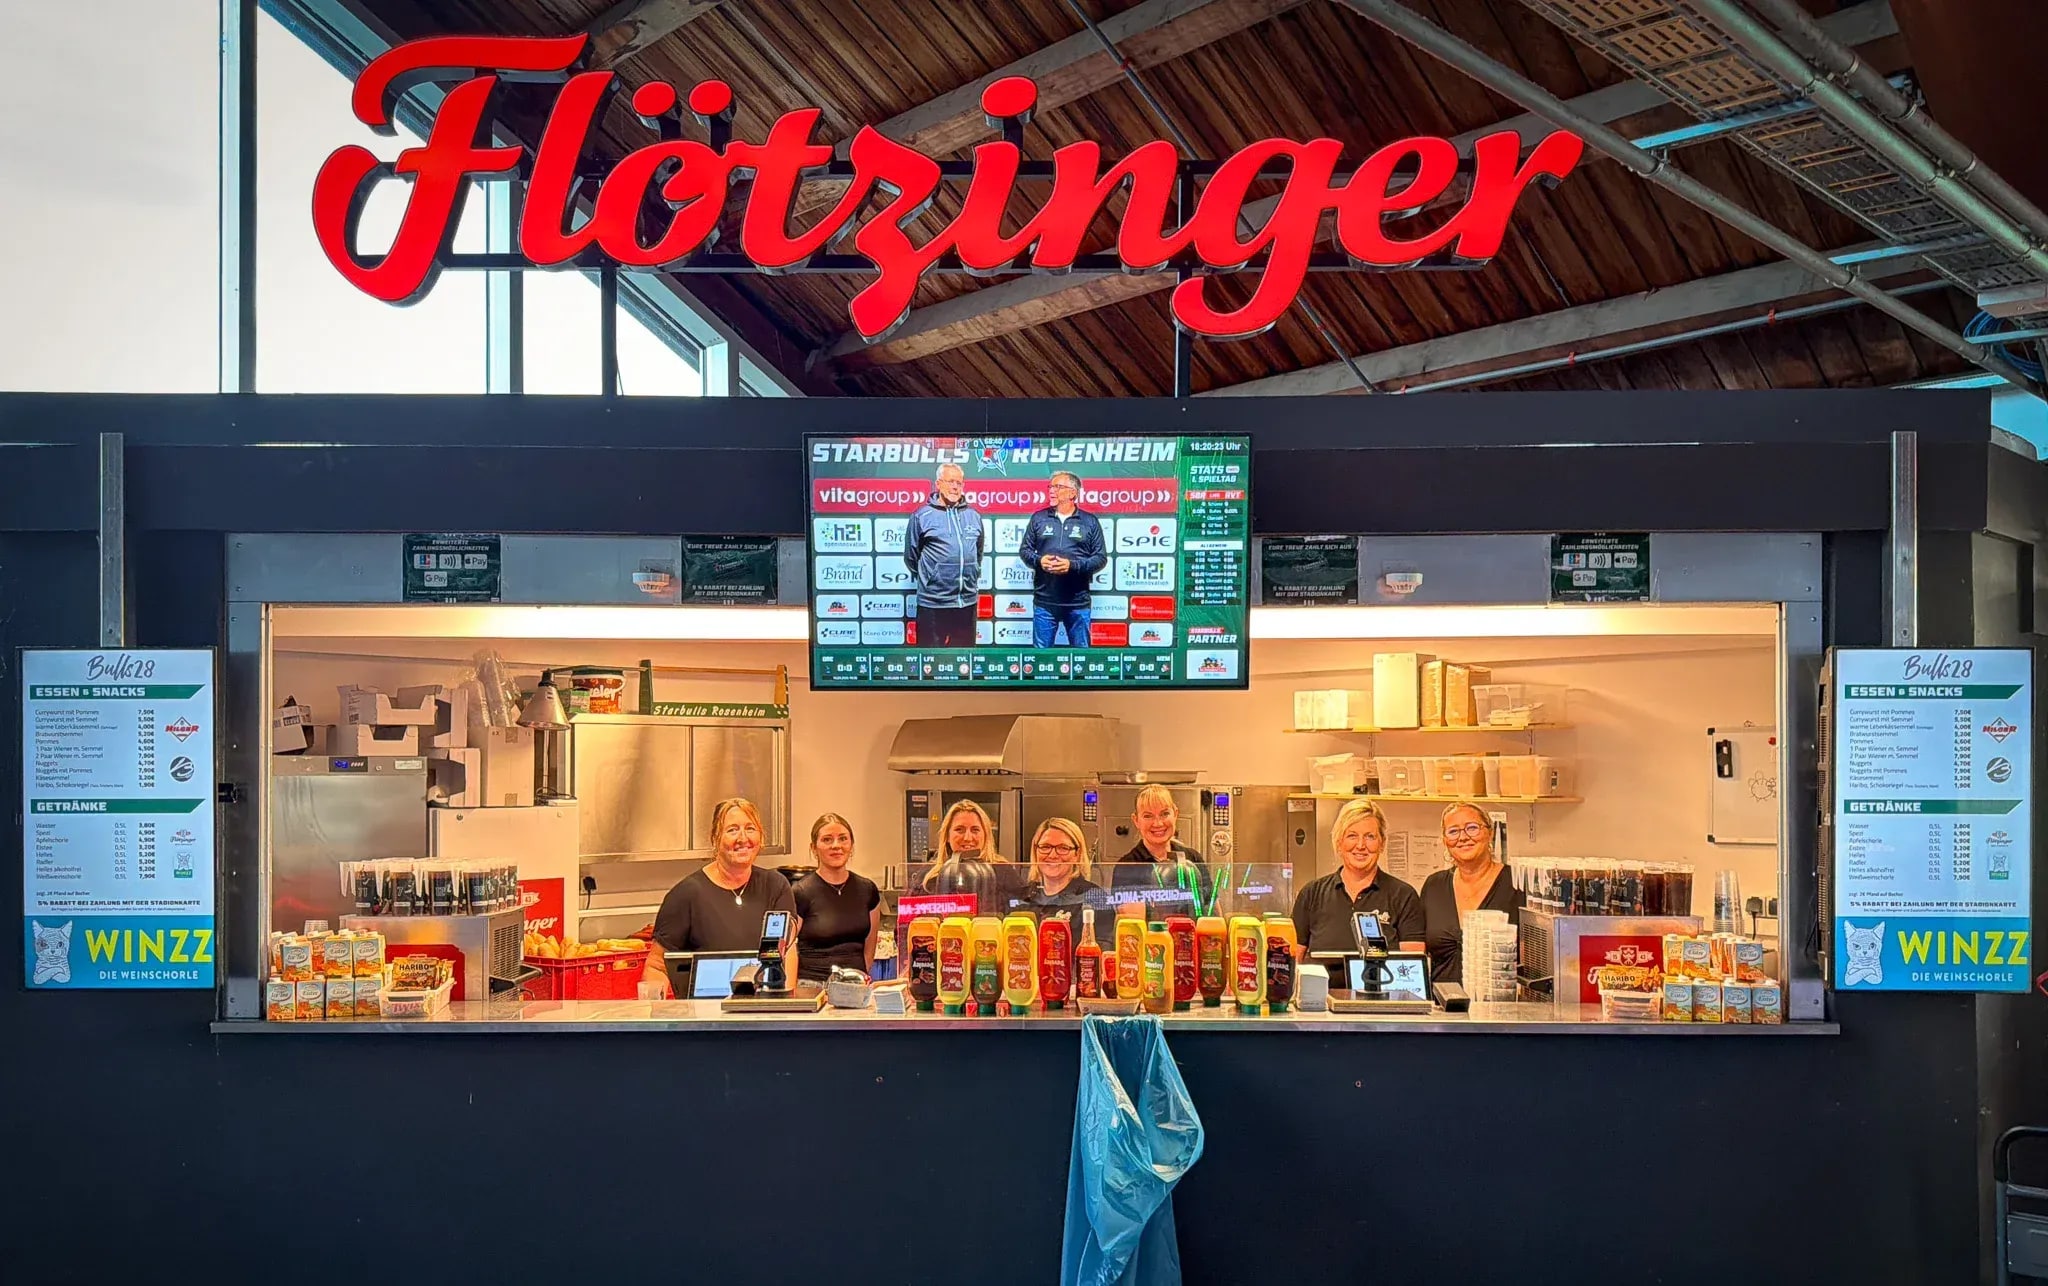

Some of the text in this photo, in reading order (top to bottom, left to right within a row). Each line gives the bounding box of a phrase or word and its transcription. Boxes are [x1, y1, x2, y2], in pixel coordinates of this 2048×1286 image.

[312, 30, 1584, 340] Flötzinger
[1190, 442, 1241, 451] 18:20:23 Uhr
[1190, 465, 1225, 474] STATS
[1198, 475, 1237, 483] SPIELTAG
[819, 487, 910, 506] vitagroup
[1122, 535, 1171, 547] SPIE
[472, 557, 486, 566] Pay
[1621, 556, 1636, 564] Pay
[822, 566, 863, 580] Brand
[1136, 562, 1165, 580] h2i
[433, 575, 447, 583] Pay
[1582, 574, 1595, 583] Pay
[1187, 634, 1237, 644] PARTNER
[86, 653, 156, 681] Bulls28
[1903, 653, 1973, 681] Bulls28
[36, 687, 146, 697] ESSEN SNACKS
[1851, 687, 1963, 697] ESSEN SNACKS
[653, 705, 766, 717] Starbulls Rosenheim
[37, 801, 107, 811] GETRÄNKE
[1850, 802, 1921, 812] GETRÄNKE
[85, 929, 212, 963] WINZZ
[1898, 930, 2029, 965] WINZZ
[100, 970, 199, 980] DIE WEINSCHORLE
[1912, 972, 2014, 982] DIE WEINSCHORLE
